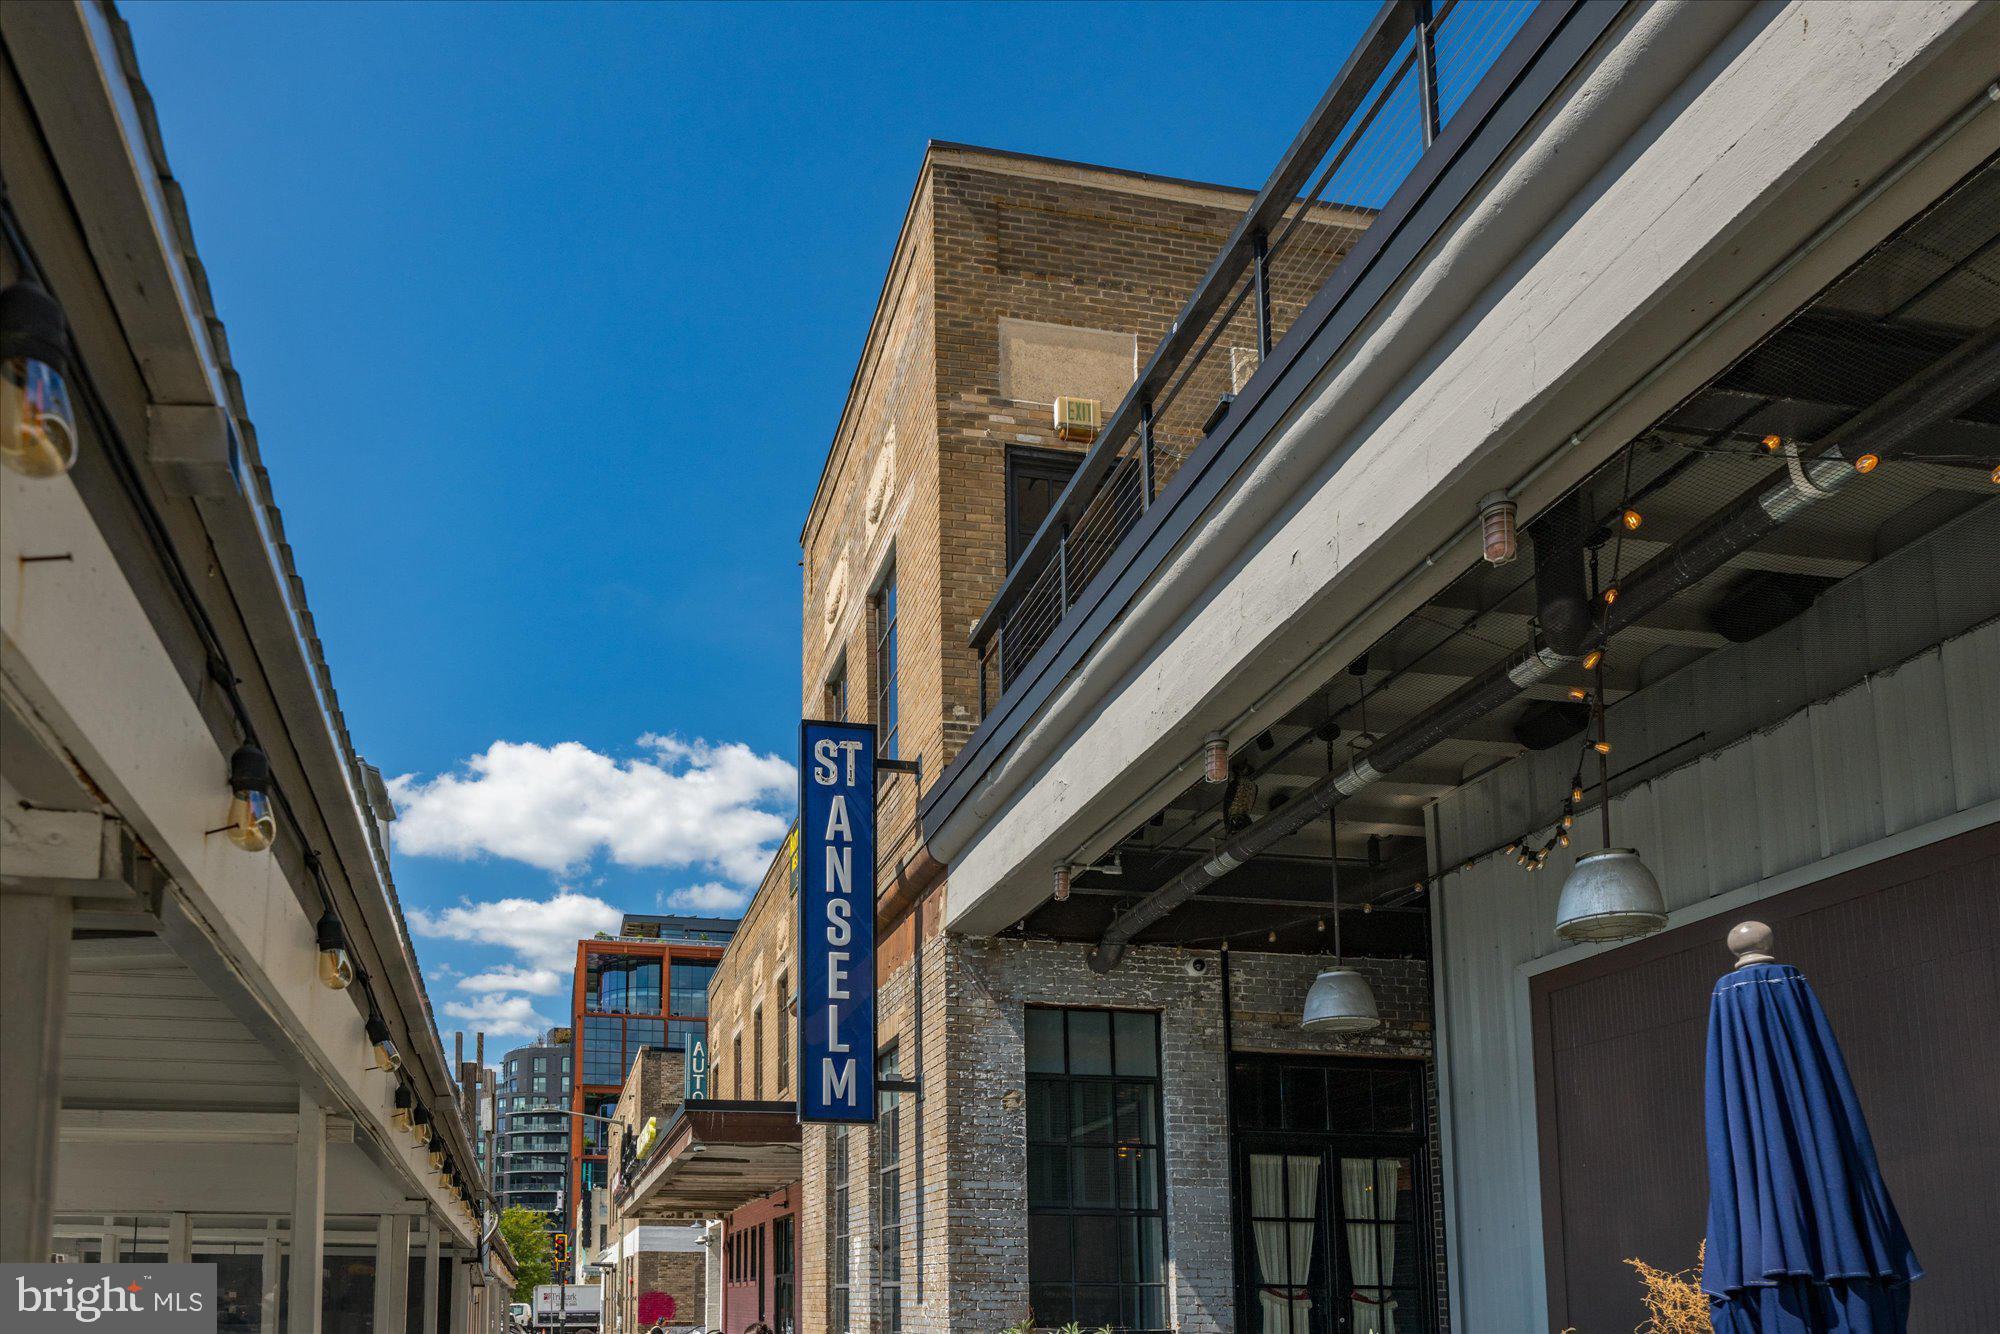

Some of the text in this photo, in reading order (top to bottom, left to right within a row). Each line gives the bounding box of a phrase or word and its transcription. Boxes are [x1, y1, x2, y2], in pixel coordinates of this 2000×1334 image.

[1067, 400, 1092, 422] EXIT
[813, 738, 863, 1107] ST ANSELM
